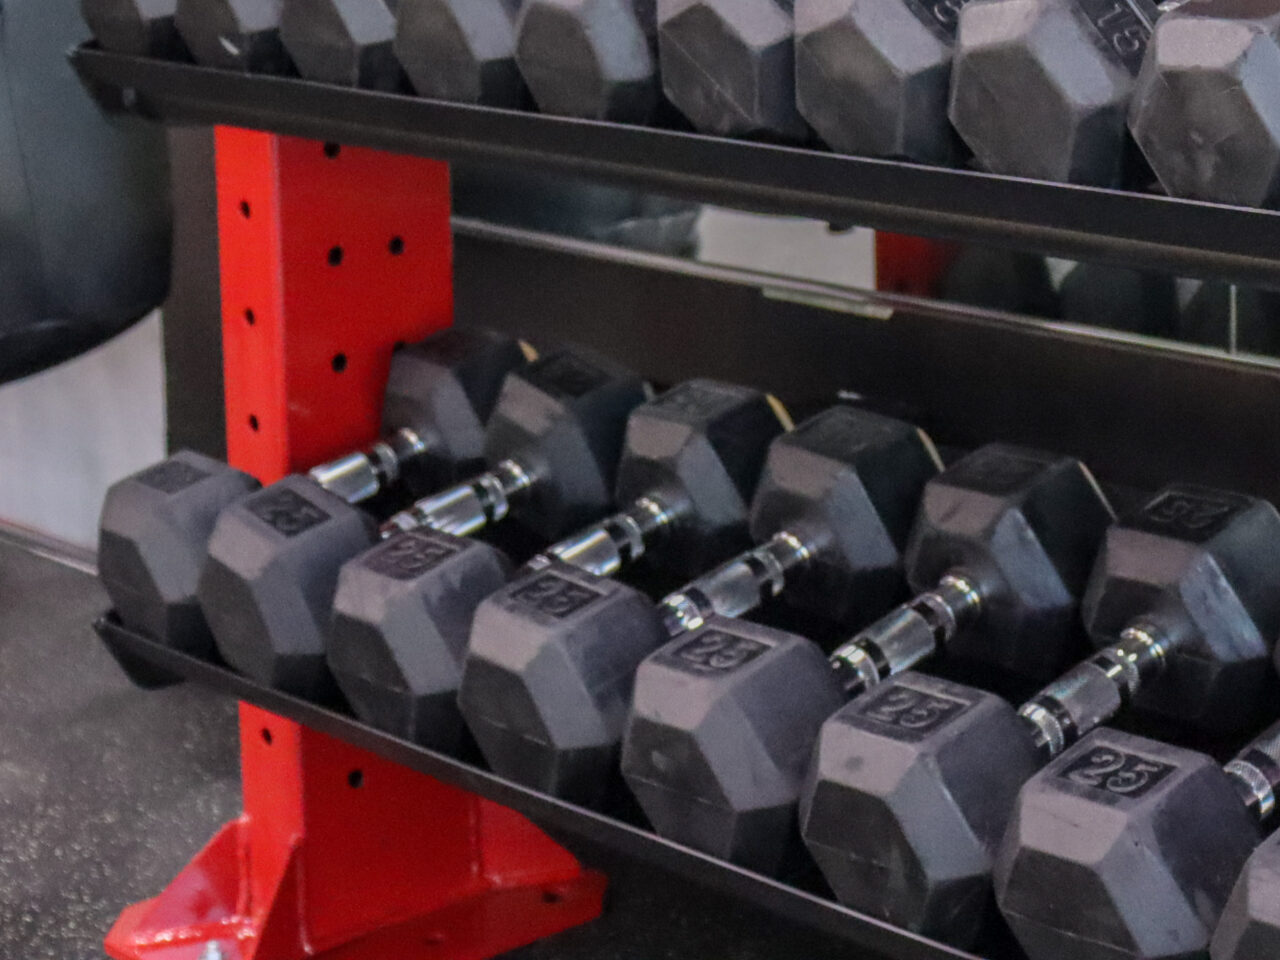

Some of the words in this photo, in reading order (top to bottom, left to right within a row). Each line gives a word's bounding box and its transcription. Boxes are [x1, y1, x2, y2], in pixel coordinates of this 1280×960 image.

[1097, 2, 1149, 57] 15
[680, 634, 758, 671] 25
[864, 692, 953, 729] 25
[1069, 753, 1163, 794] 25
